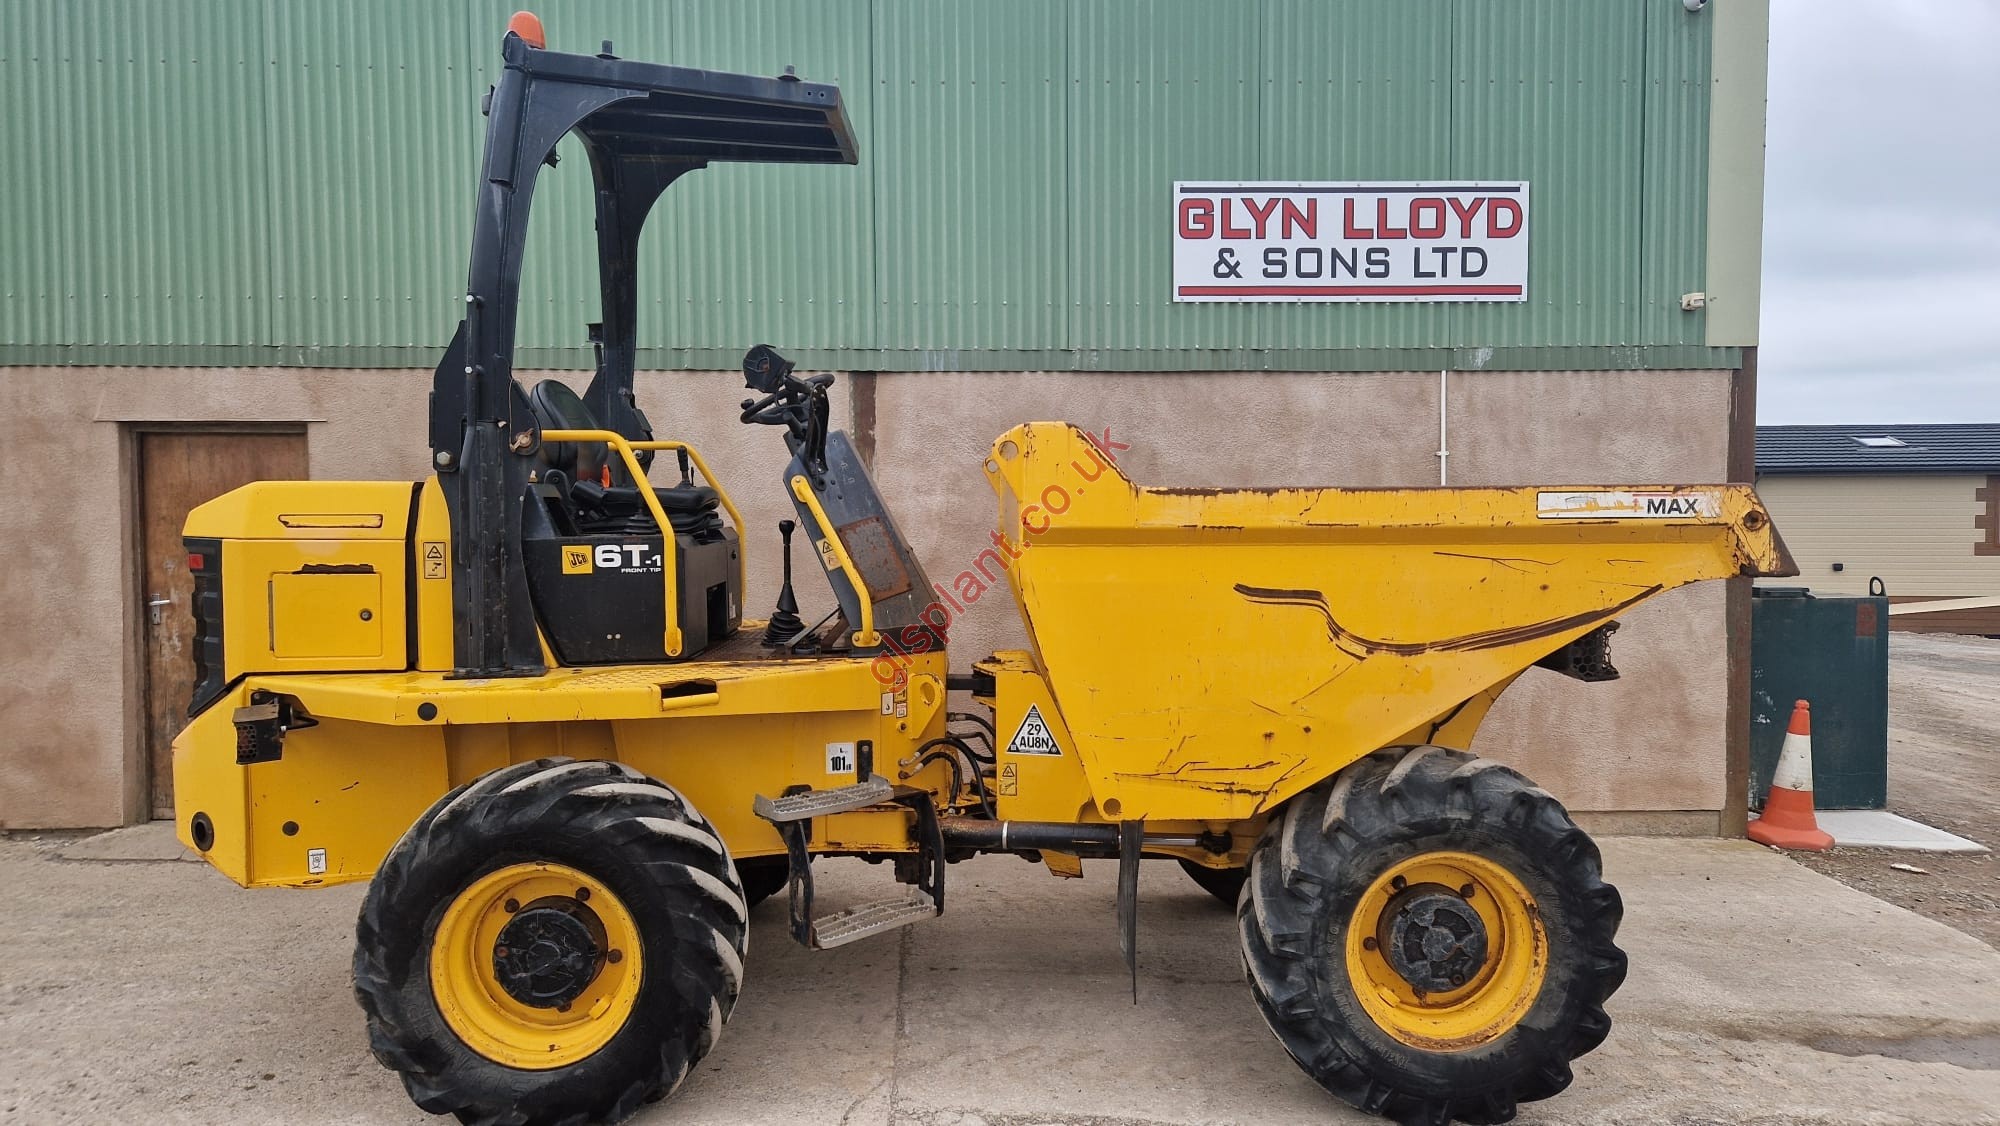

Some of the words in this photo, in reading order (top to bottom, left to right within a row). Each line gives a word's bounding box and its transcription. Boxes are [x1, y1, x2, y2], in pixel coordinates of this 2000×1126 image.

[1178, 197, 1317, 240] GLYN
[1343, 197, 1524, 240] LLOYD
[1213, 247, 1243, 279] &
[1262, 247, 1390, 279] SONS
[1413, 246, 1488, 279] LTD
[1647, 498, 1698, 515] MAX
[569, 552, 588, 567] JCB
[1027, 723, 1042, 736] 29
